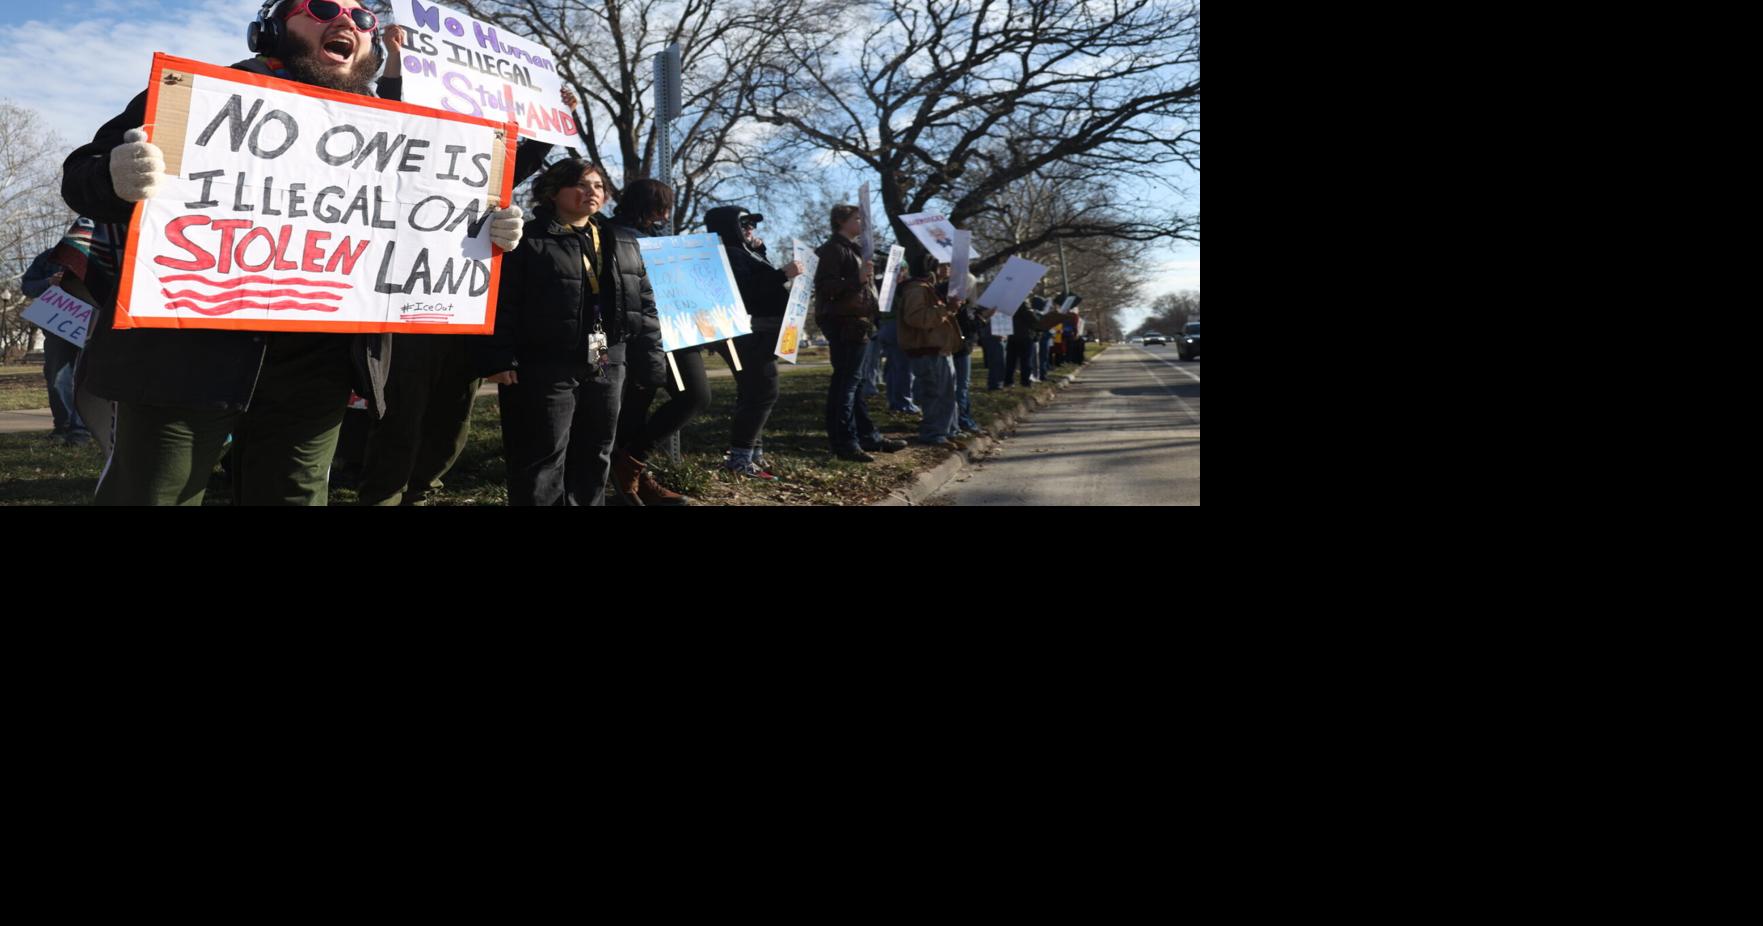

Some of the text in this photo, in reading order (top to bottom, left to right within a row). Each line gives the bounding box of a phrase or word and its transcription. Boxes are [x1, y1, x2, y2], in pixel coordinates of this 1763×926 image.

[399, 25, 438, 56] IS
[195, 94, 491, 187] NO ONE IS
[185, 169, 495, 238] ILLEGAL ON
[153, 214, 490, 297] STOLEN LAND
[47, 313, 86, 340] ICE
